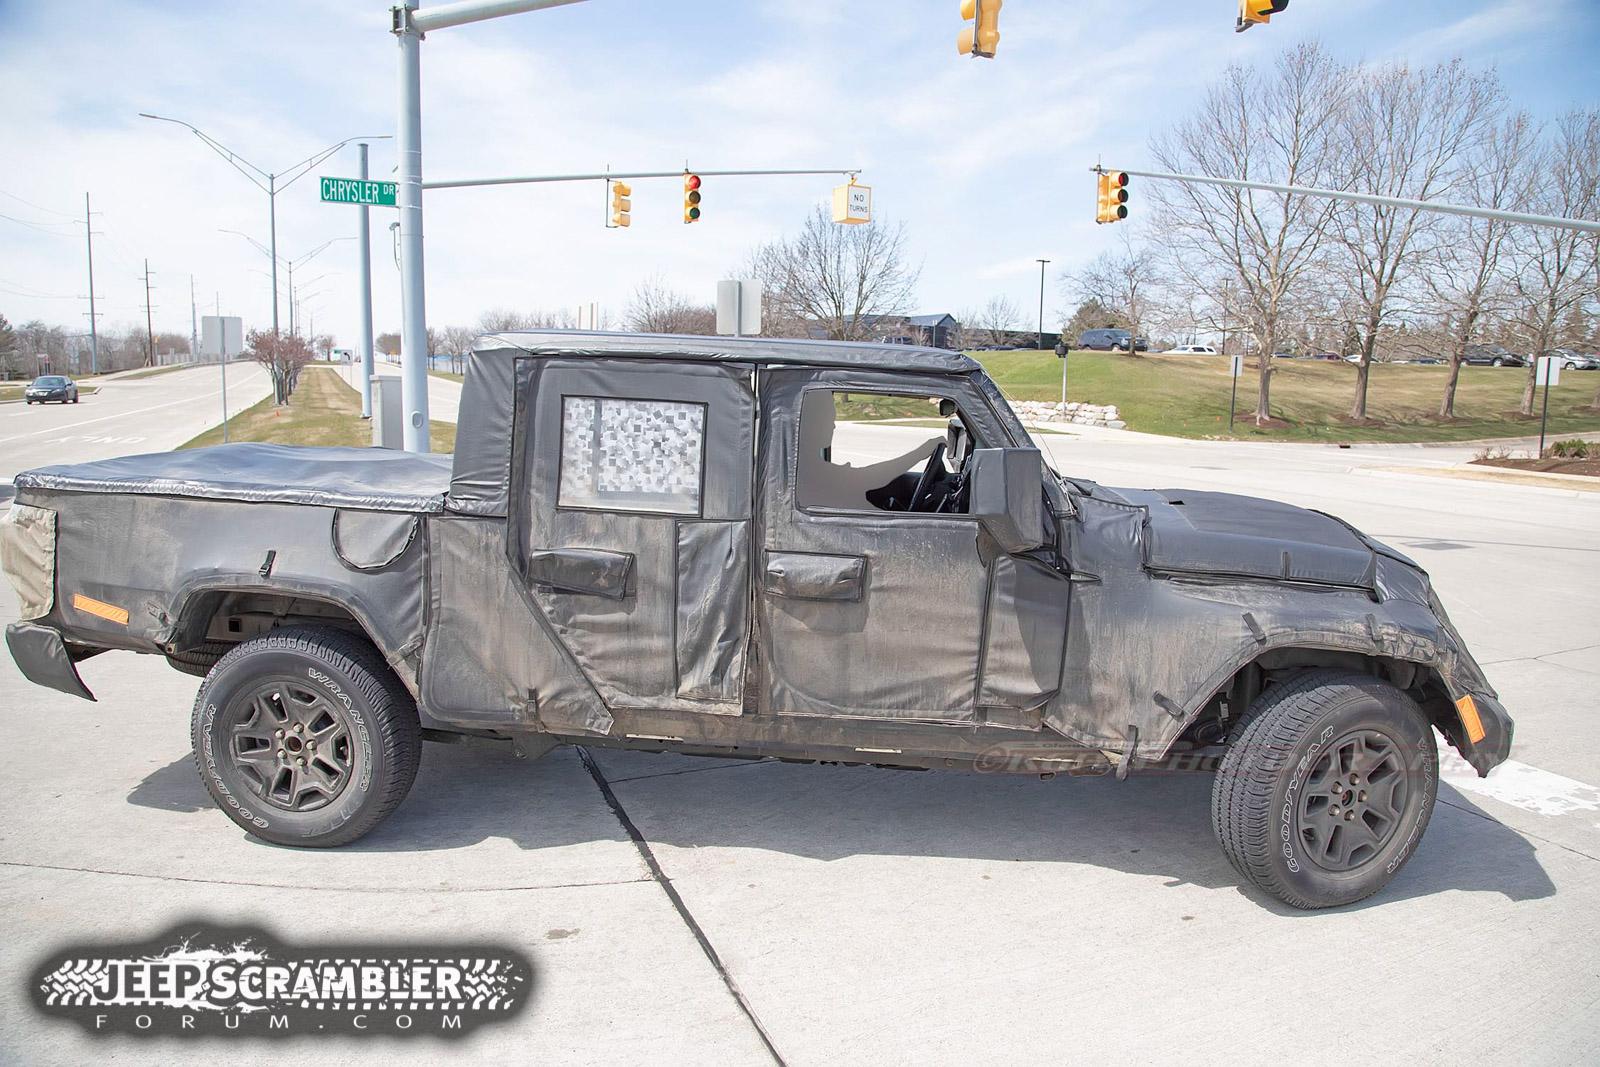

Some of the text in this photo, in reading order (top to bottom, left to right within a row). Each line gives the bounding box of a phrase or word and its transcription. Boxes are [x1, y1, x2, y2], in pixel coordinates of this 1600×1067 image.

[322, 179, 395, 203] CHRYSLER DR
[850, 204, 868, 213] TURNS
[853, 194, 865, 202] NO
[203, 703, 270, 830] GOODYEAR
[308, 667, 374, 792] WRANGLER
[1280, 725, 1334, 874] GOODYEAR
